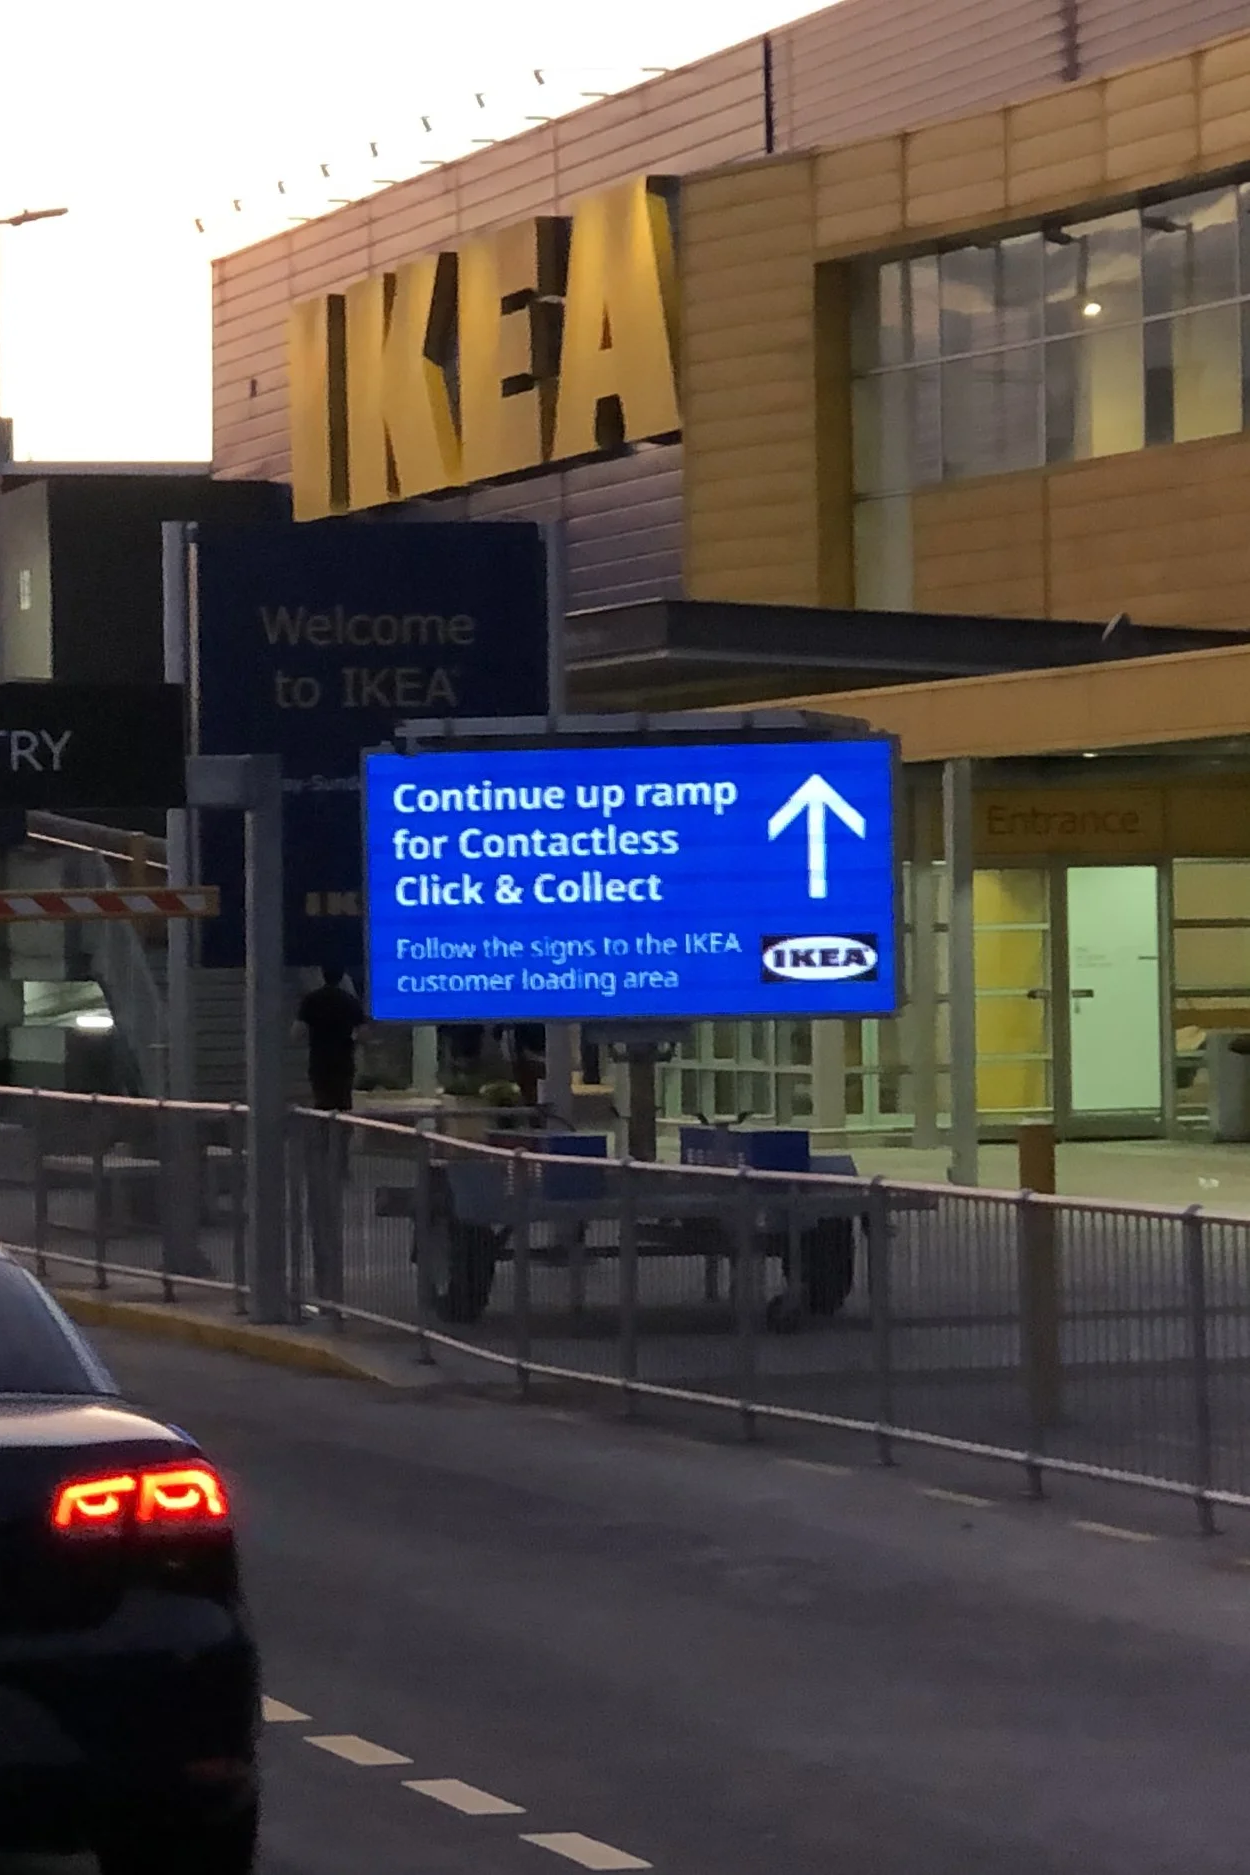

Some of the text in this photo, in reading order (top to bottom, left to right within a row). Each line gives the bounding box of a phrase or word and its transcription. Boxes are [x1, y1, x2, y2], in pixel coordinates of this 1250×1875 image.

[287, 174, 682, 523] IKEA
[258, 604, 476, 646] Welcome
[273, 667, 459, 709] to IKEA
[393, 779, 738, 818] Continue up ramp
[986, 804, 1141, 836] Entrance
[393, 824, 680, 860] for Contactless
[395, 870, 663, 906] Click & Collect
[396, 931, 743, 965] Follow the signs to the IKEA
[770, 946, 869, 969] IKEA
[396, 966, 679, 997] customer loading area
